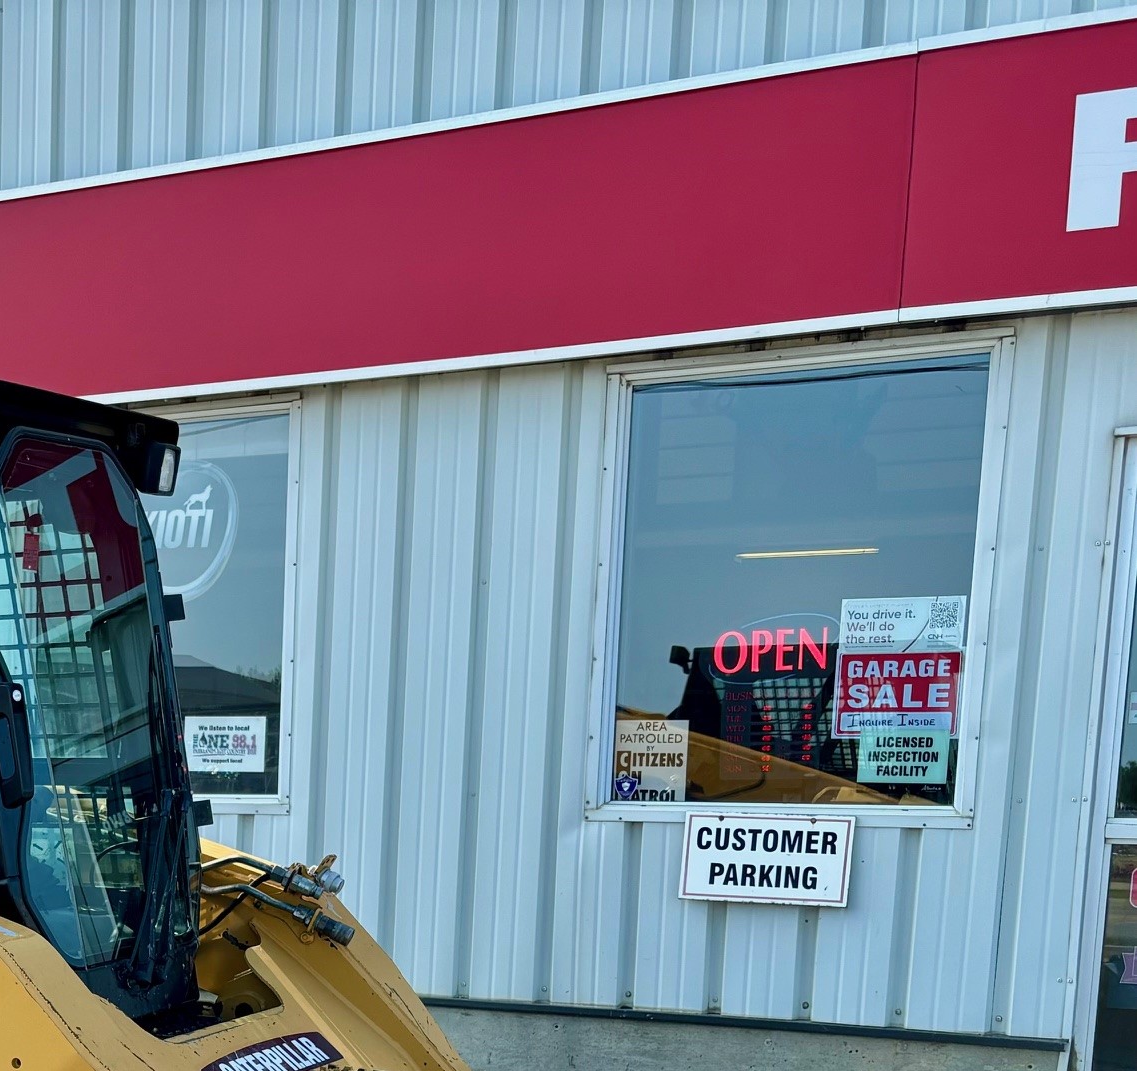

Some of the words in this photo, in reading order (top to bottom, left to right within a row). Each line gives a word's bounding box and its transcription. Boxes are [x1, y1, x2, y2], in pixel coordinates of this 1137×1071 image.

[847, 610, 869, 620] You
[872, 610, 902, 620] drive
[905, 609, 916, 619] it.
[847, 622, 875, 632] We'll
[879, 622, 895, 631] do
[846, 634, 865, 644] the
[868, 634, 895, 643] rest.
[714, 627, 828, 674] OPEN
[847, 659, 952, 678] GARAGE
[847, 683, 951, 709] SALE
[636, 722, 668, 732] AREA
[620, 734, 683, 744] PATROLLED
[876, 736, 934, 748] LICENSED
[620, 752, 684, 768] CITIZENS
[868, 751, 939, 763] INSPECTION
[876, 765, 929, 777] FACILITY
[697, 827, 838, 855] CUSTOMER
[709, 863, 818, 890] PARKING
